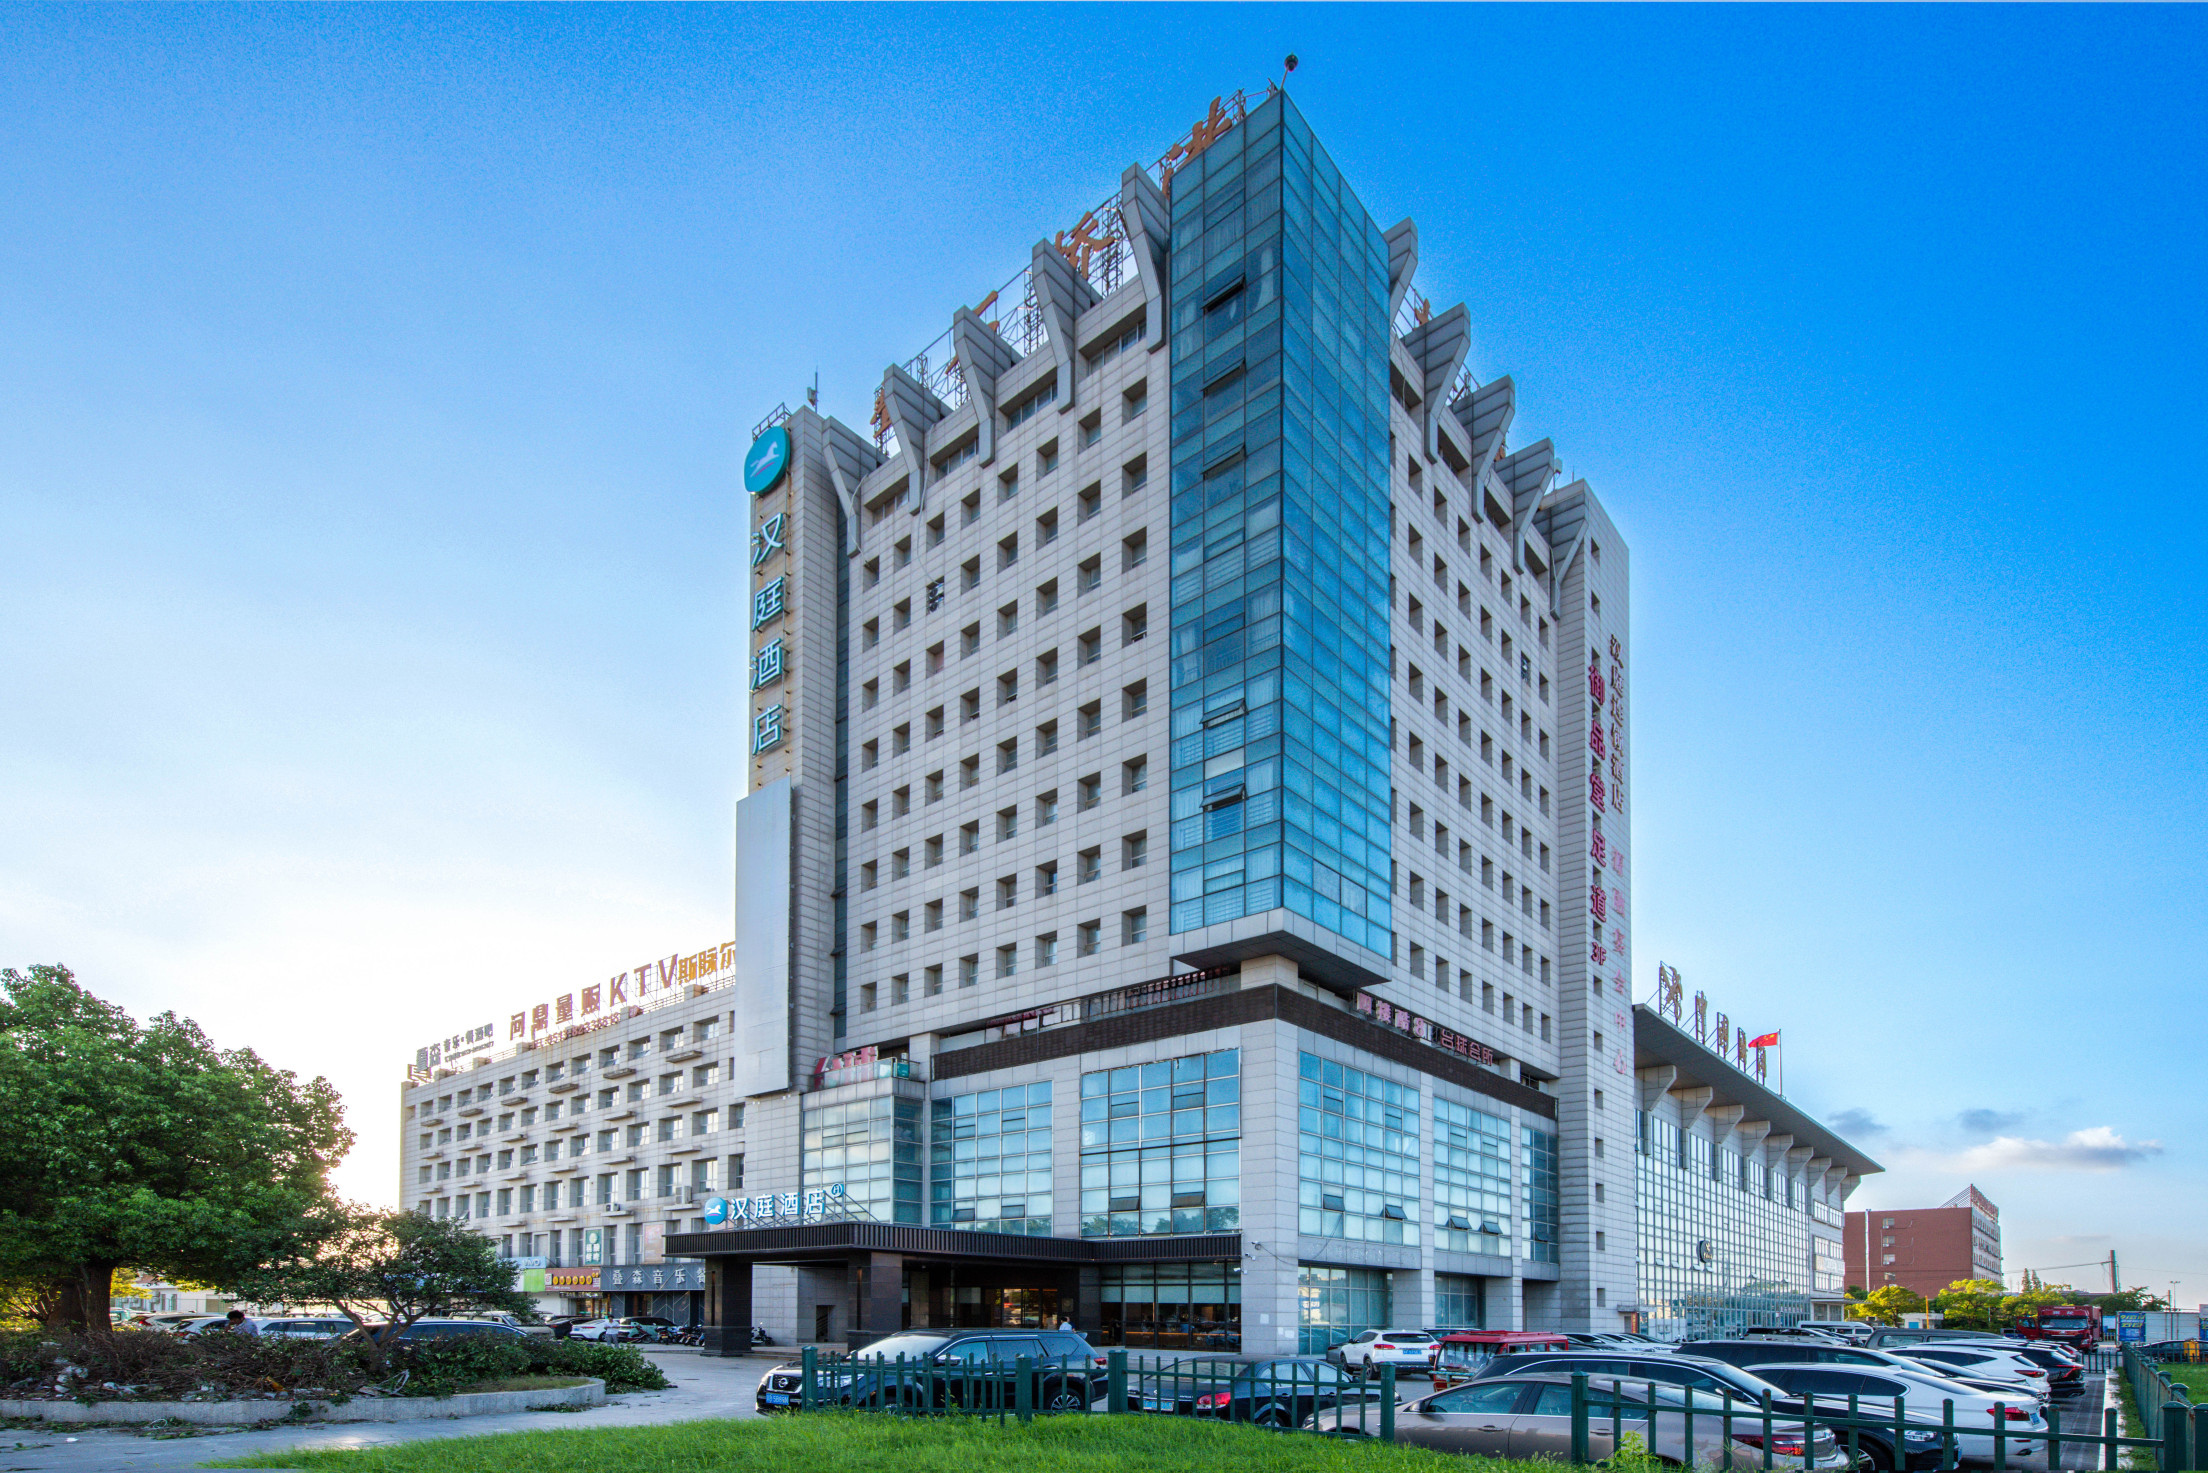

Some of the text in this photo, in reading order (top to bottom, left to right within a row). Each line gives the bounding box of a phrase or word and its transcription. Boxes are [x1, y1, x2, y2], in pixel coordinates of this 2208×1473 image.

[751, 511, 786, 757] 汉庭酒店
[1440, 1028, 1494, 1067] 台球会所
[730, 1189, 826, 1220] 汉庭酒店
